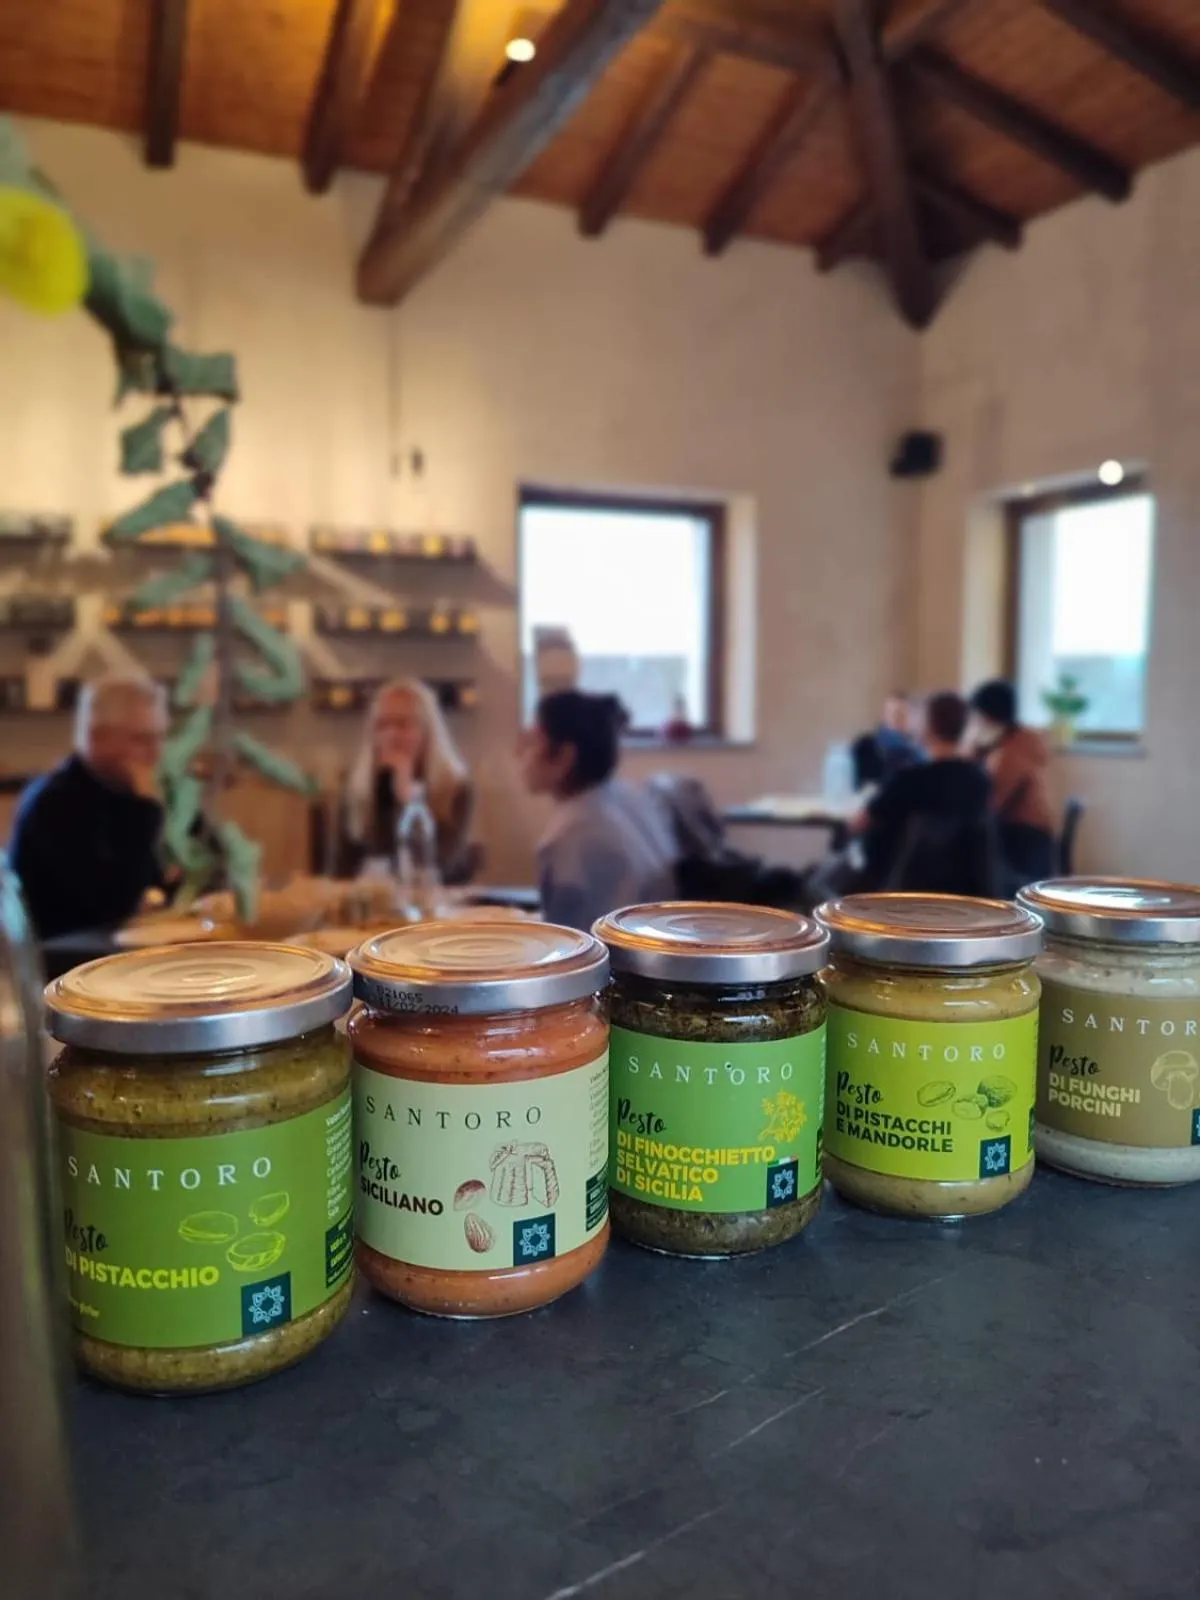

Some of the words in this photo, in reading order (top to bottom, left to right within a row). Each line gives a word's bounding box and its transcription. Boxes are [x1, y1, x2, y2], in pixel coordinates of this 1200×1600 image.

[847, 1032, 1005, 1062] SANTORO
[1050, 1044, 1101, 1076] Pesto
[628, 1056, 793, 1085] SANTORO
[837, 1070, 883, 1104] Pesto
[1050, 1072, 1064, 1091] DI
[1069, 1078, 1141, 1103] FUNGHI
[366, 1096, 541, 1130] SANTORO
[617, 1097, 666, 1134] Pesto
[836, 1101, 849, 1119] DI
[854, 1108, 951, 1135] PISTACCHI
[1049, 1088, 1121, 1117] PORCINI
[616, 1130, 631, 1149] DI
[635, 1136, 776, 1165] FINOCCHIETTO
[836, 1118, 844, 1132] E
[848, 1124, 953, 1152] MANDORLE
[67, 1155, 272, 1191] SANTORO
[360, 1140, 401, 1181] Pesto
[616, 1149, 719, 1183] SELVATICO
[360, 1178, 443, 1216] SICILIANO
[616, 1167, 630, 1187] DI
[635, 1174, 703, 1201] SICILIA
[63, 1208, 108, 1253] Pesto
[64, 1246, 77, 1271] DI
[79, 1255, 220, 1290] PISTACCHIO
